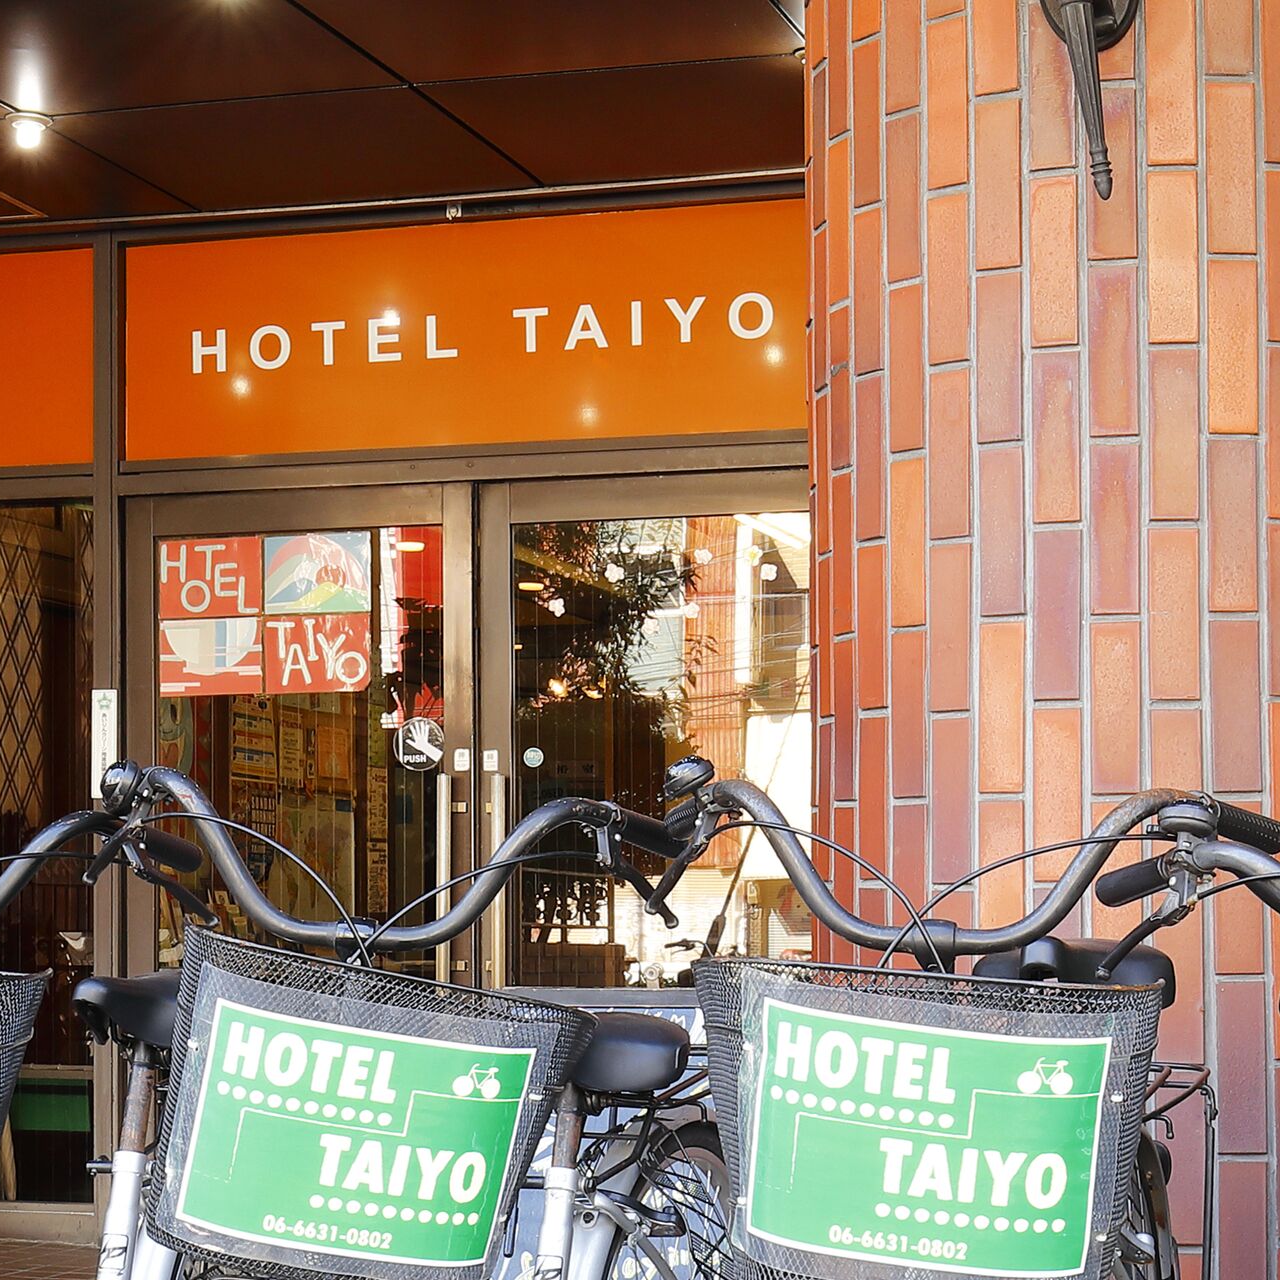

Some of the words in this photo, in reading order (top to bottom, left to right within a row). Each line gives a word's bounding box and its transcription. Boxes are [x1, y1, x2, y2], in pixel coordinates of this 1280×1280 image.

[191, 314, 458, 375] HOTEL
[513, 291, 775, 353] TAIYO
[160, 543, 260, 614] HOTEL
[266, 618, 368, 687] TAIYO
[403, 754, 427, 763] PUSH
[222, 1020, 398, 1105] HOTEL
[773, 1020, 957, 1105] HOTEL
[318, 1132, 487, 1204] TAIYO
[879, 1137, 1069, 1210] TAIYO
[262, 1213, 393, 1250] 06-6631-0802
[828, 1224, 969, 1261] 06-6631-0802
